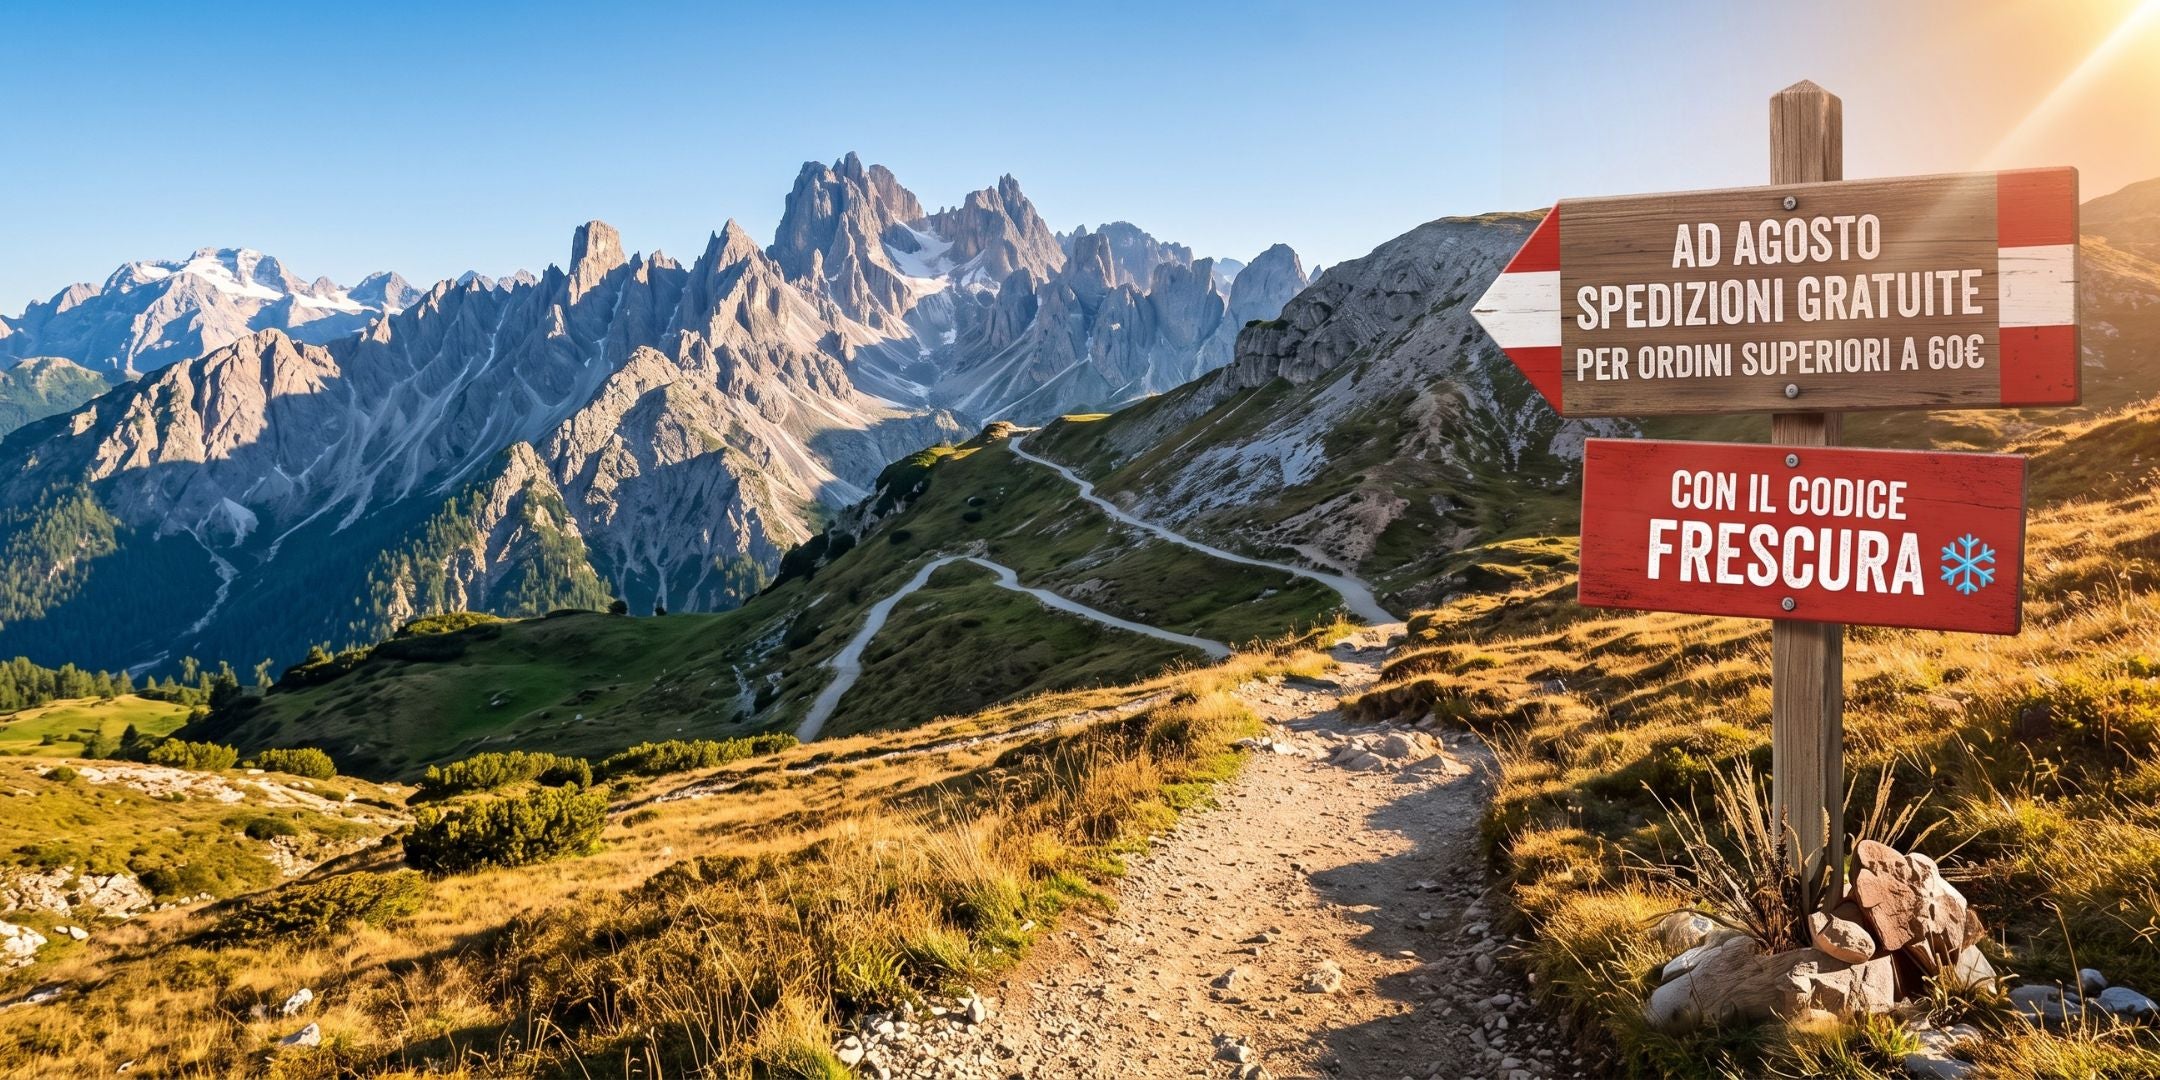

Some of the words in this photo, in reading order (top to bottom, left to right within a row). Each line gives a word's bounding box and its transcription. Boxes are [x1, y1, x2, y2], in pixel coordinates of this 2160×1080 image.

[1671, 222, 1720, 268] AD
[1733, 213, 1881, 266] AGOSTO
[1576, 277, 1784, 331] SPEDIZIONI
[1797, 269, 1984, 322] GRATUITE
[1576, 346, 1629, 382] PER
[1638, 342, 1732, 379] ORDINI
[1741, 337, 1891, 376] SUPERIORI
[1900, 337, 1919, 371] A
[1928, 334, 1985, 370] 60€
[1671, 469, 1737, 511] CON
[1749, 474, 1777, 513] IL
[1788, 475, 1907, 520] CODICE
[1647, 518, 1925, 596] FRESCURA
